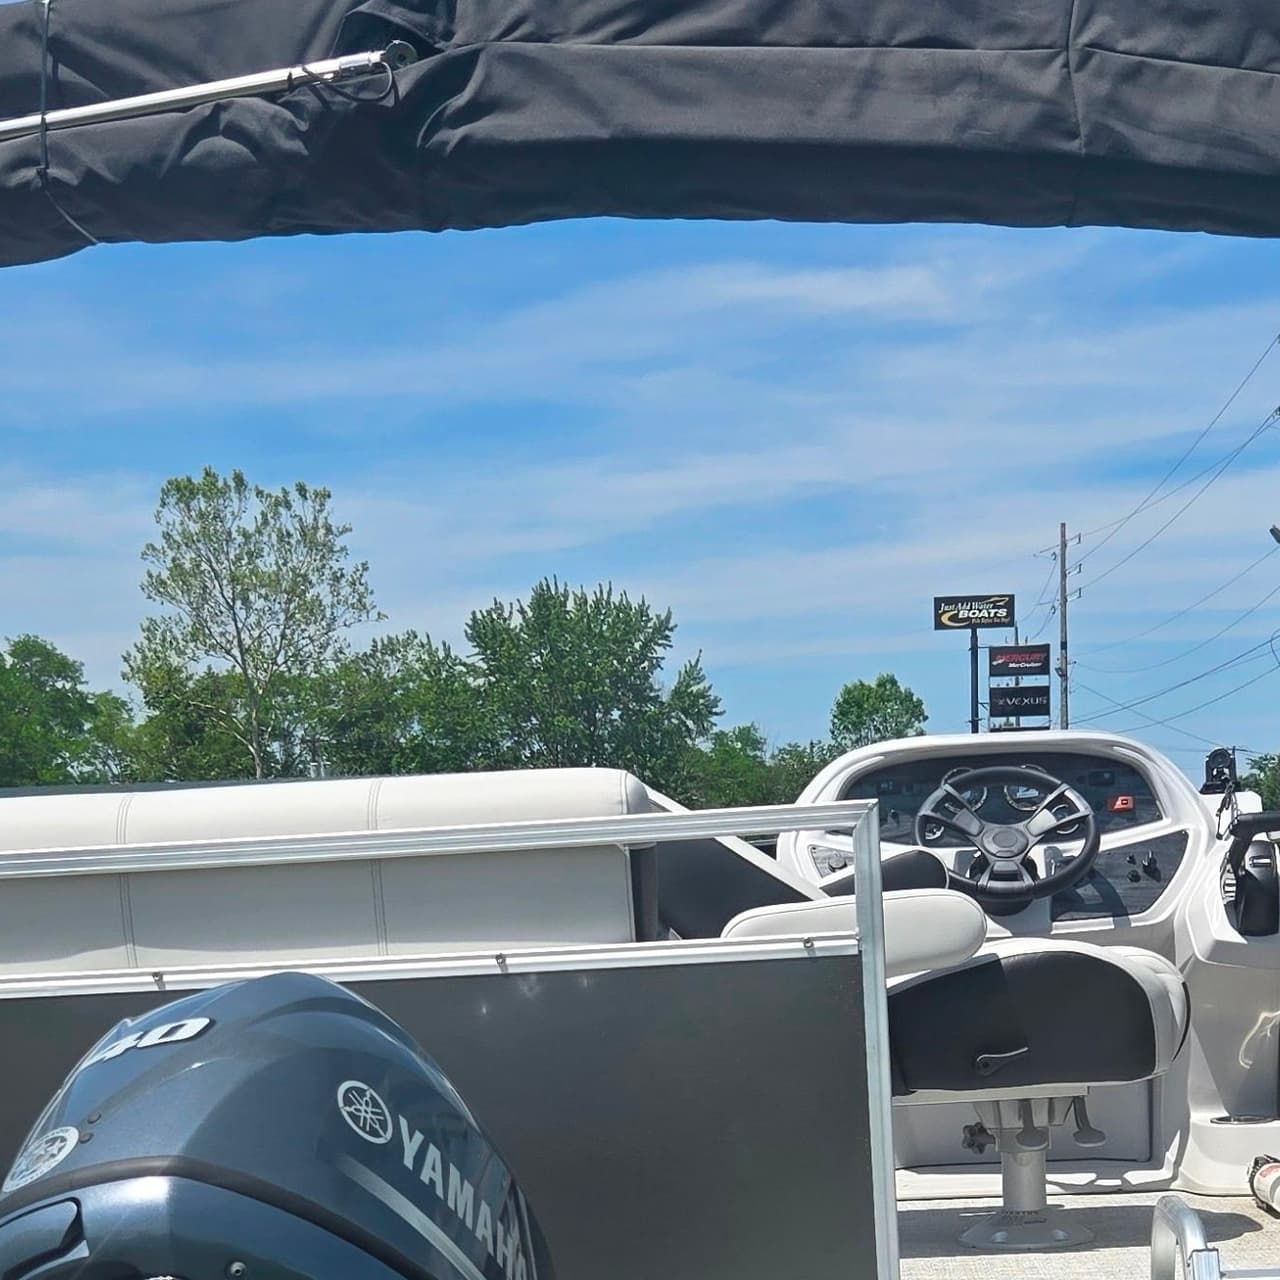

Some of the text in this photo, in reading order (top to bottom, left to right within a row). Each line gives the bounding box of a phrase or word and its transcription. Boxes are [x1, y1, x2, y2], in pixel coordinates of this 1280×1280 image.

[938, 601, 994, 613] Just Add Water
[958, 608, 1008, 618] BOATS
